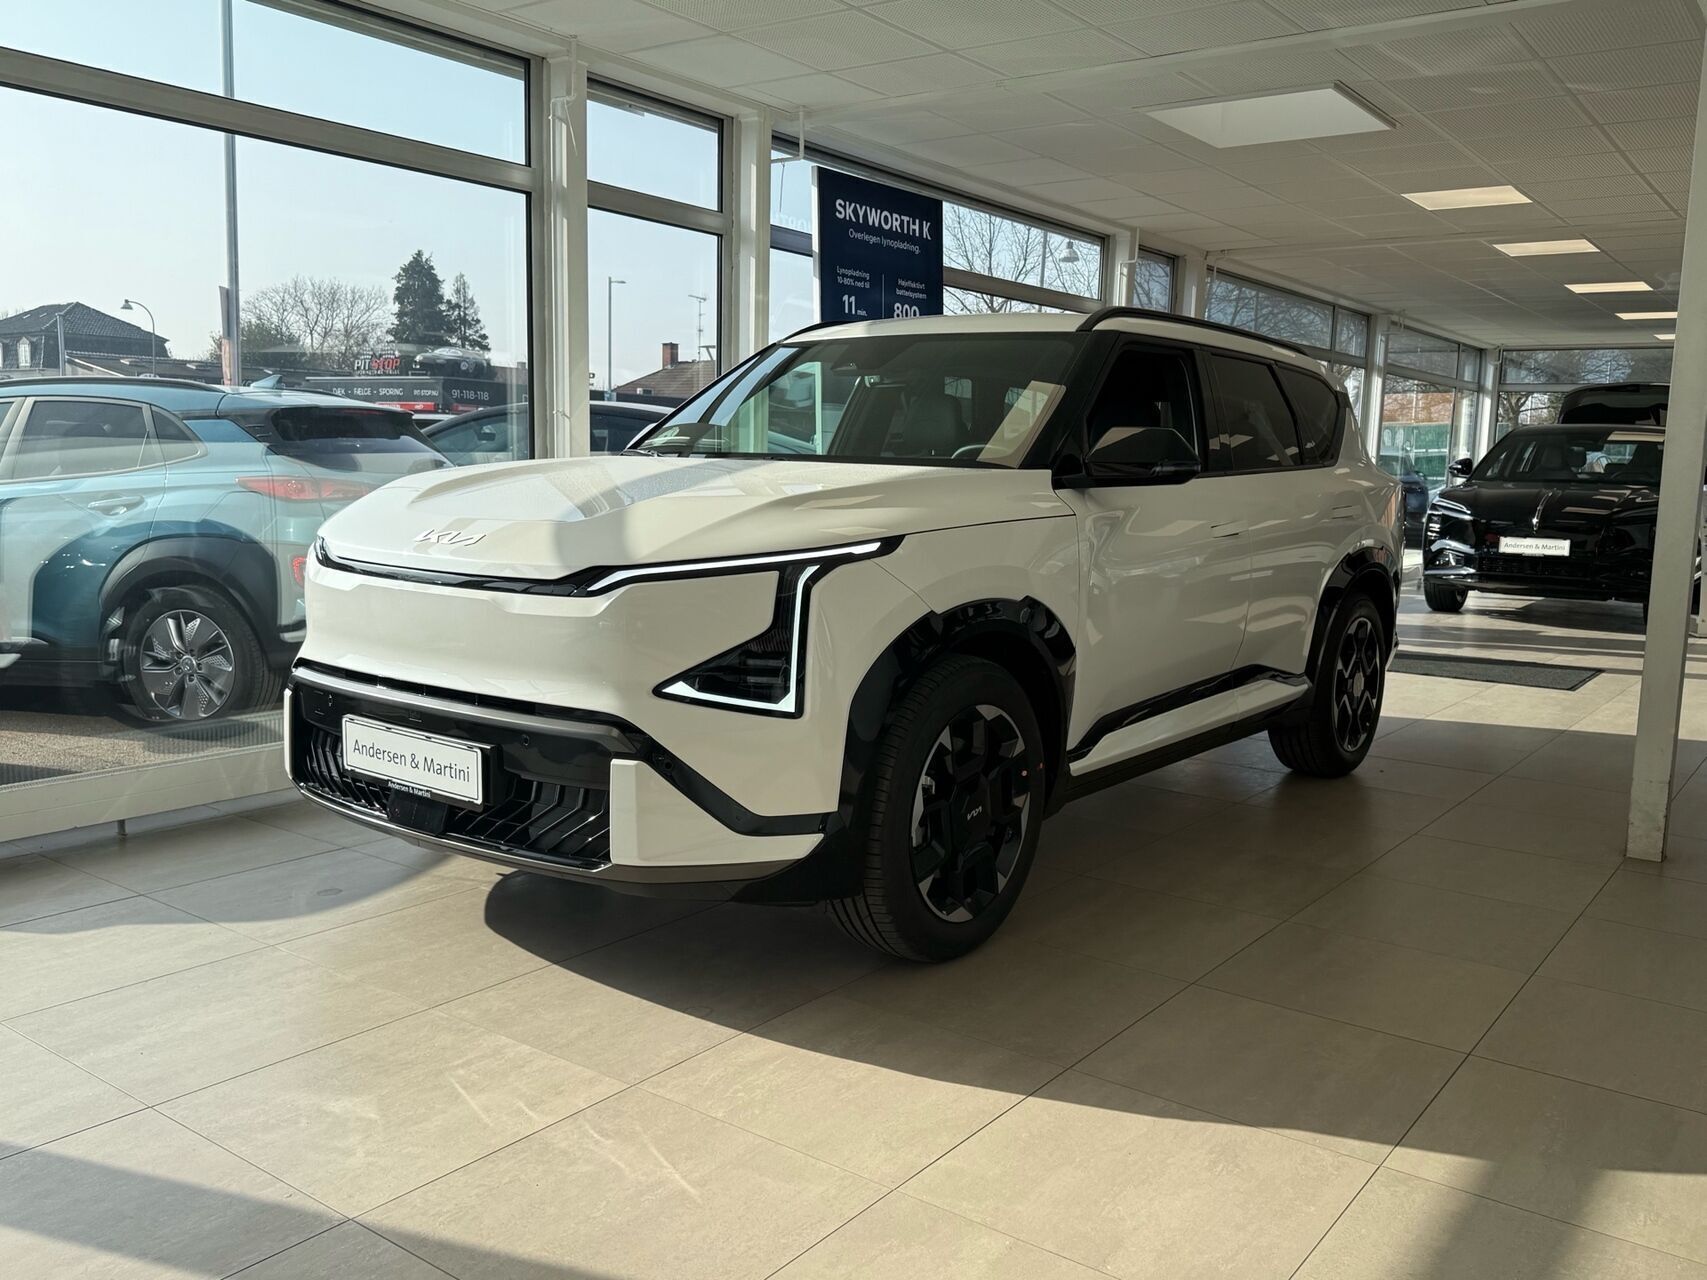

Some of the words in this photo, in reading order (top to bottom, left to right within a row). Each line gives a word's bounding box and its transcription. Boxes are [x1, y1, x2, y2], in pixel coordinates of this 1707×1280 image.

[835, 199, 919, 237] SKYWORTH
[923, 220, 932, 240] K
[848, 229, 881, 245] Overlegen
[881, 236, 921, 255] lynopladning.
[836, 266, 870, 280] Lynopladning
[855, 280, 864, 288] ned
[842, 294, 856, 315] 11
[893, 302, 920, 319] 800
[354, 360, 371, 370] PIT
[371, 358, 400, 369] STOP
[378, 387, 404, 396] SPORING
[451, 389, 489, 401] 91-118-118
[1504, 542, 1533, 550] Andersen
[353, 739, 407, 767] Andersen
[410, 753, 420, 770] &
[423, 756, 470, 783] Martini
[387, 781, 409, 793] Andersen
[409, 786, 414, 794] &
[413, 788, 431, 798] Martini
